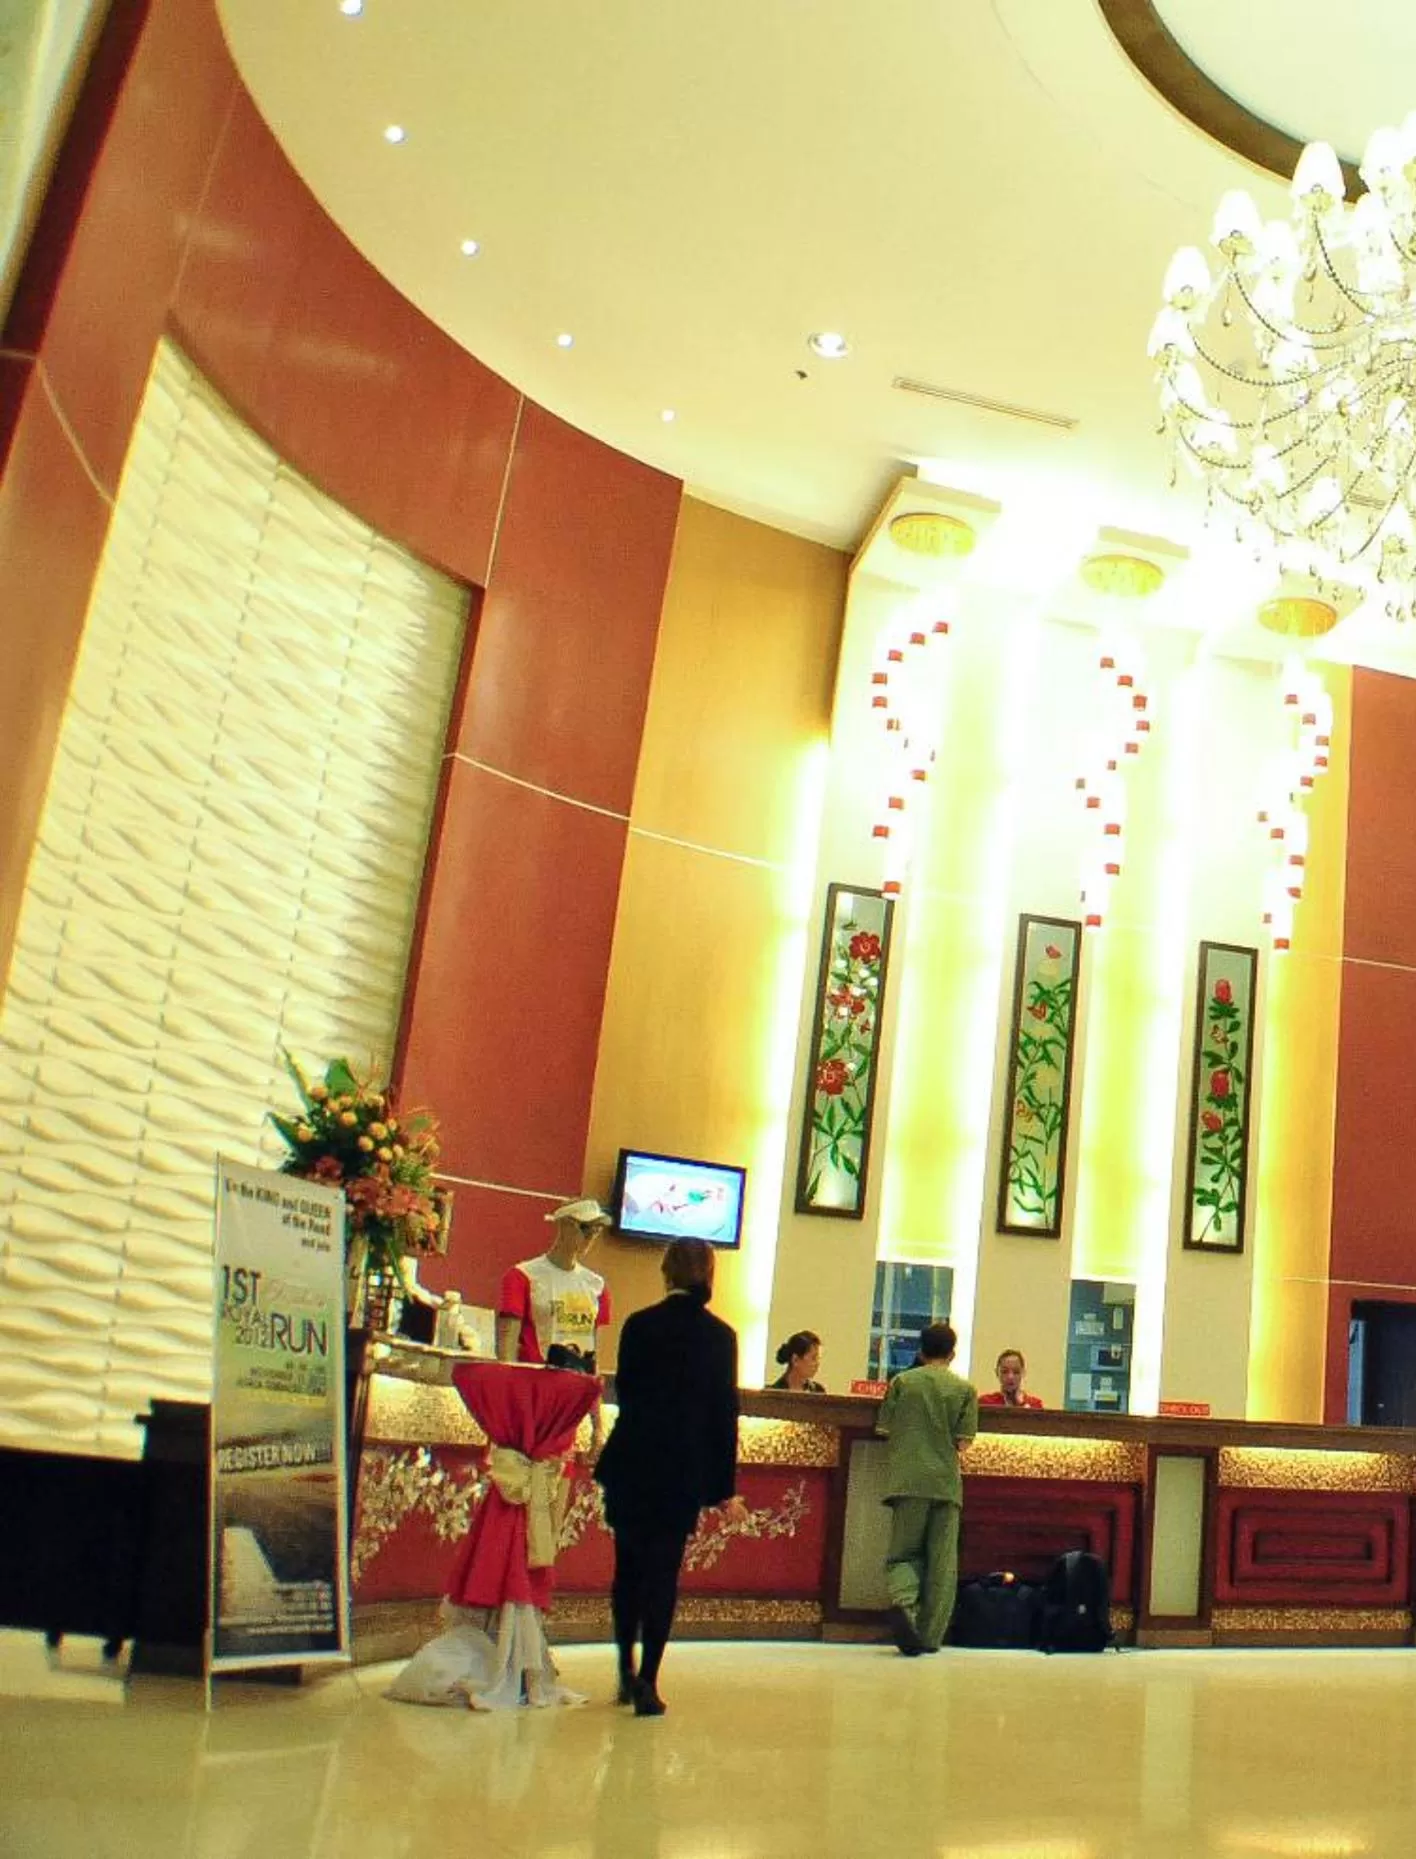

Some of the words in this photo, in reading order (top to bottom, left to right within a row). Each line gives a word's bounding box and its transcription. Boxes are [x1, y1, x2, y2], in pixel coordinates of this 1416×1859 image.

[222, 1263, 262, 1306] 1ST
[270, 1311, 328, 1357] RUN
[217, 1443, 280, 1472] REGISTER
